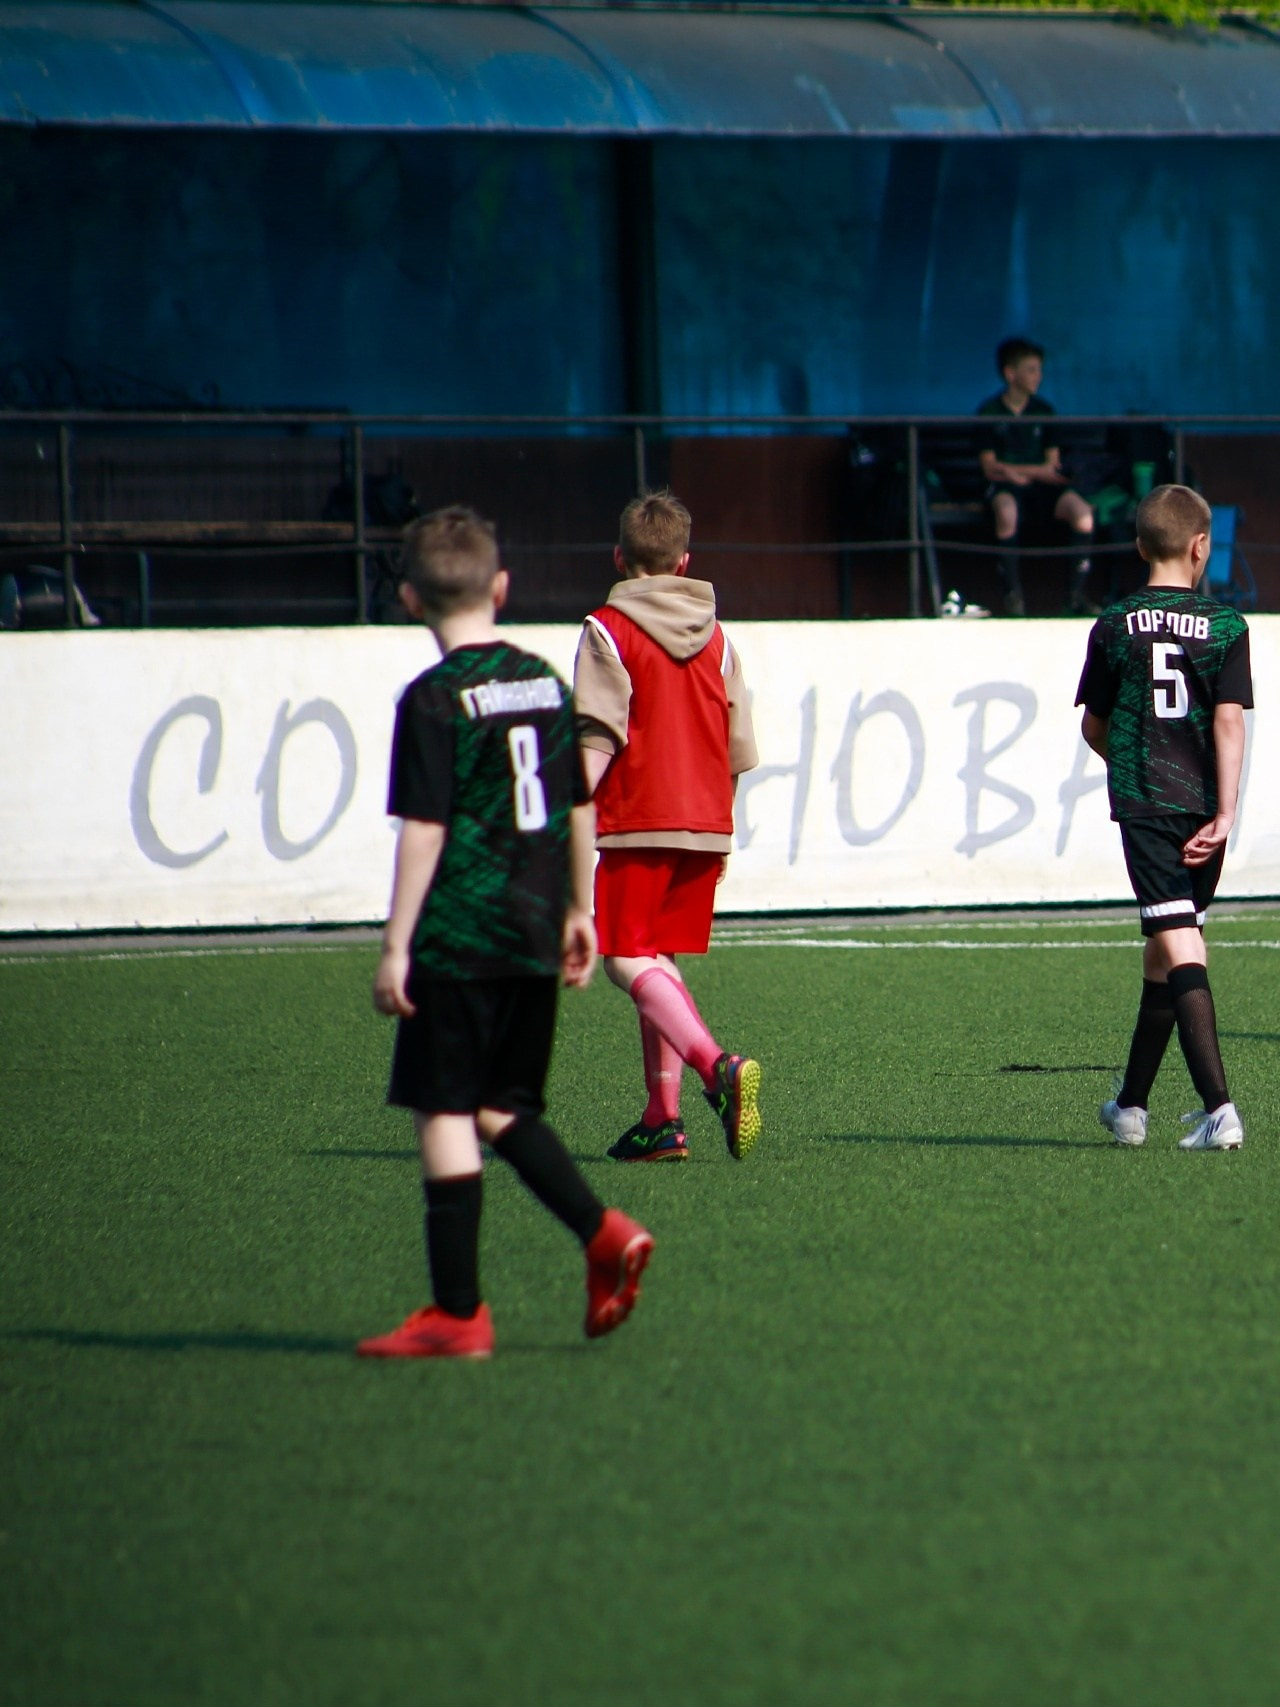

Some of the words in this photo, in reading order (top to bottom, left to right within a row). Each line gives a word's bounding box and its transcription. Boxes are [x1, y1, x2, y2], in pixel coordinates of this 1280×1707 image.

[1126, 609, 1210, 640] ГОРЛОВ
[1152, 642, 1189, 719] 5
[508, 724, 549, 832] 8
